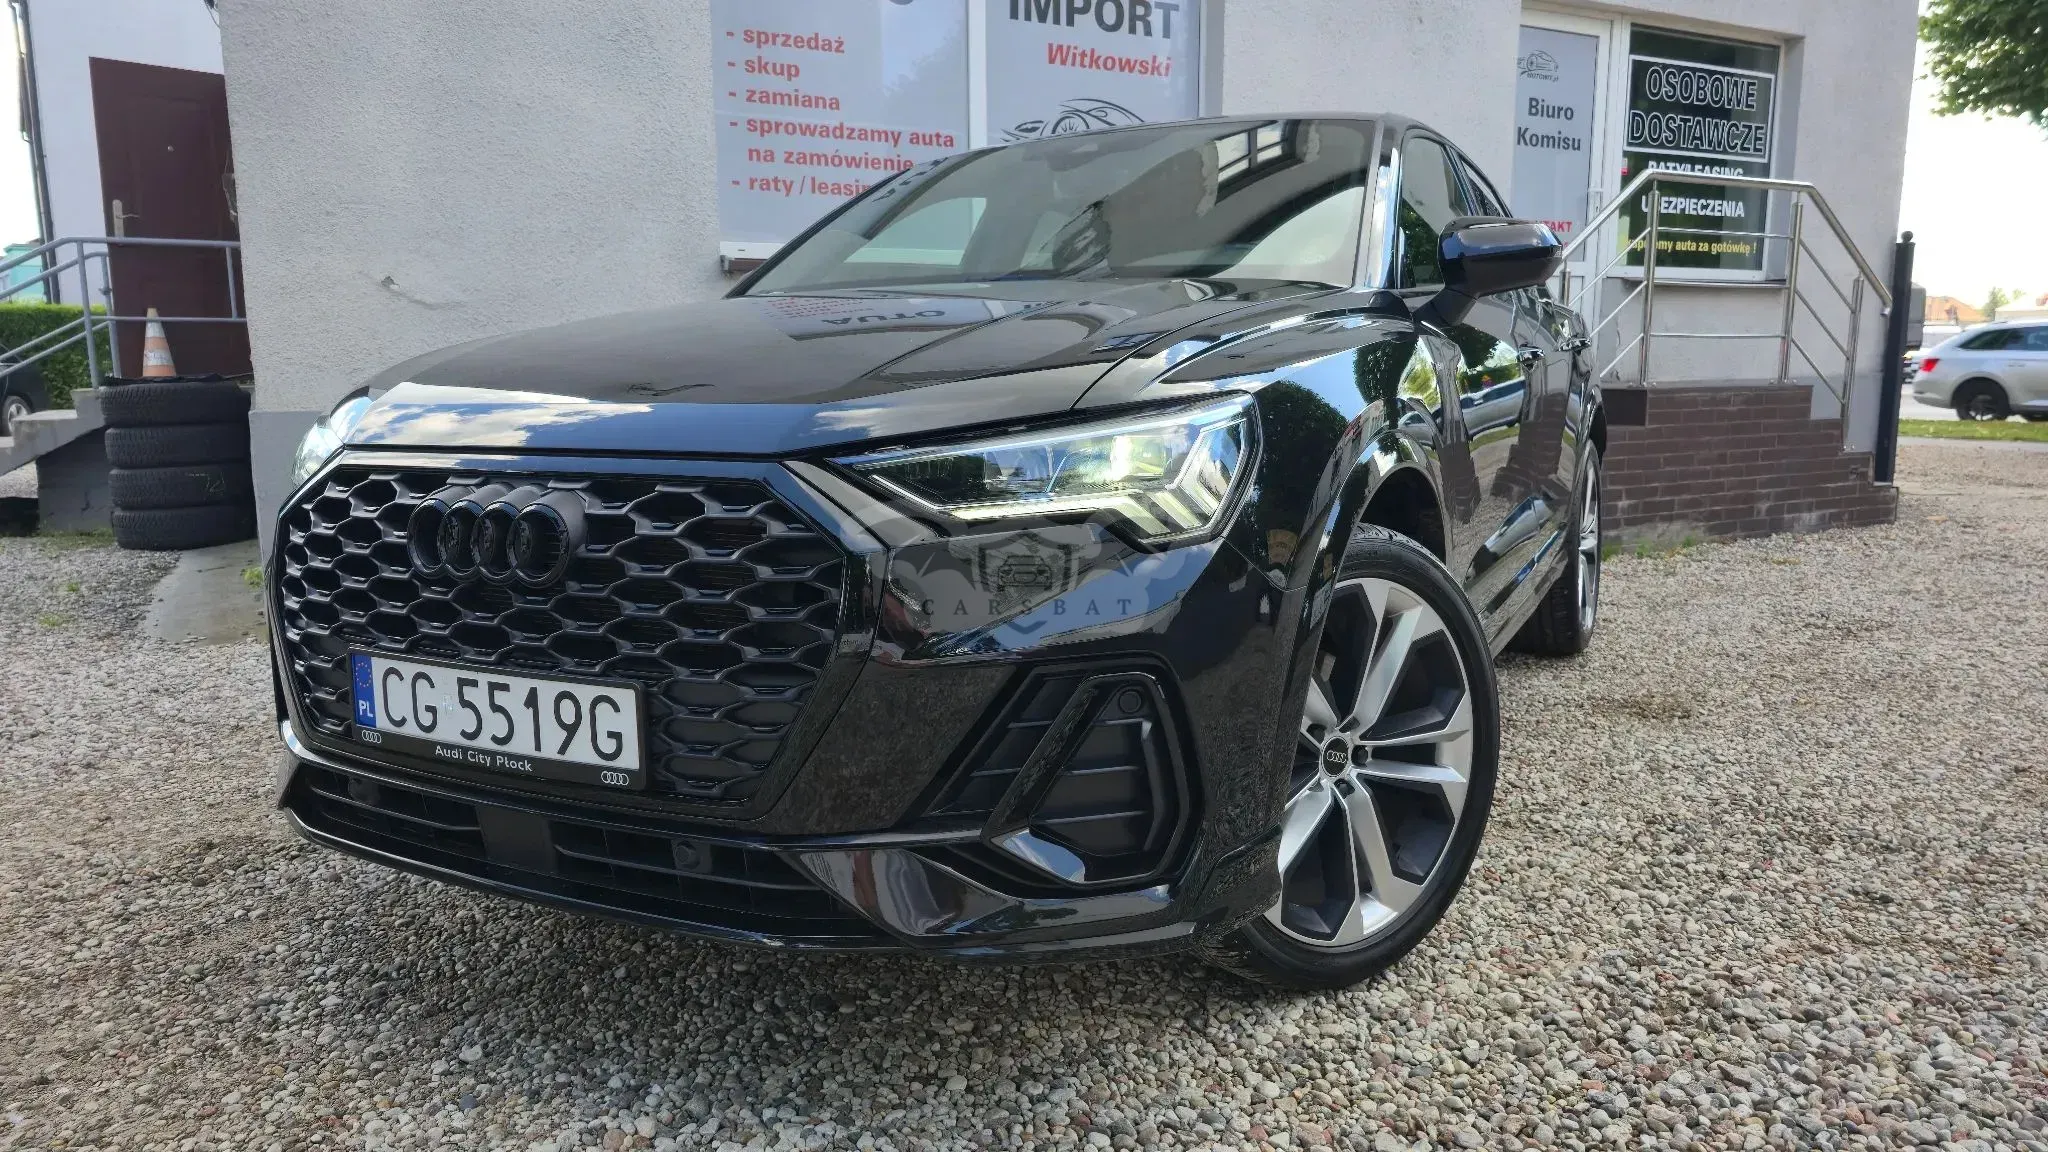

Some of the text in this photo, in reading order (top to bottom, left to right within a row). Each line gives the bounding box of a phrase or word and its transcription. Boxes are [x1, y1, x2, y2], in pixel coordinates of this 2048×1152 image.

[1009, 0, 1179, 39] IMPORT
[742, 27, 845, 54] sprzedaż
[744, 56, 800, 81] skup
[1047, 42, 1172, 77] Witkowski
[745, 88, 840, 111] zamiana
[1646, 66, 1757, 111] OSOBOWE
[1528, 97, 1574, 121] Biuro
[746, 118, 902, 148] sprowadzamy
[909, 129, 954, 148] auta
[1517, 127, 1581, 151] Komisu
[1629, 110, 1765, 154] DOSTAWCZE
[748, 148, 914, 171] na zamówienie
[749, 176, 794, 197] raty
[1641, 195, 1745, 217] UEZPIECZENIA
[1675, 240, 1696, 252] auta
[1698, 241, 1709, 252] za
[1711, 240, 1750, 256] gotówkę
[358, 666, 623, 762] PL CG 5519G
[435, 744, 462, 760] Audi
[467, 751, 491, 767] City
